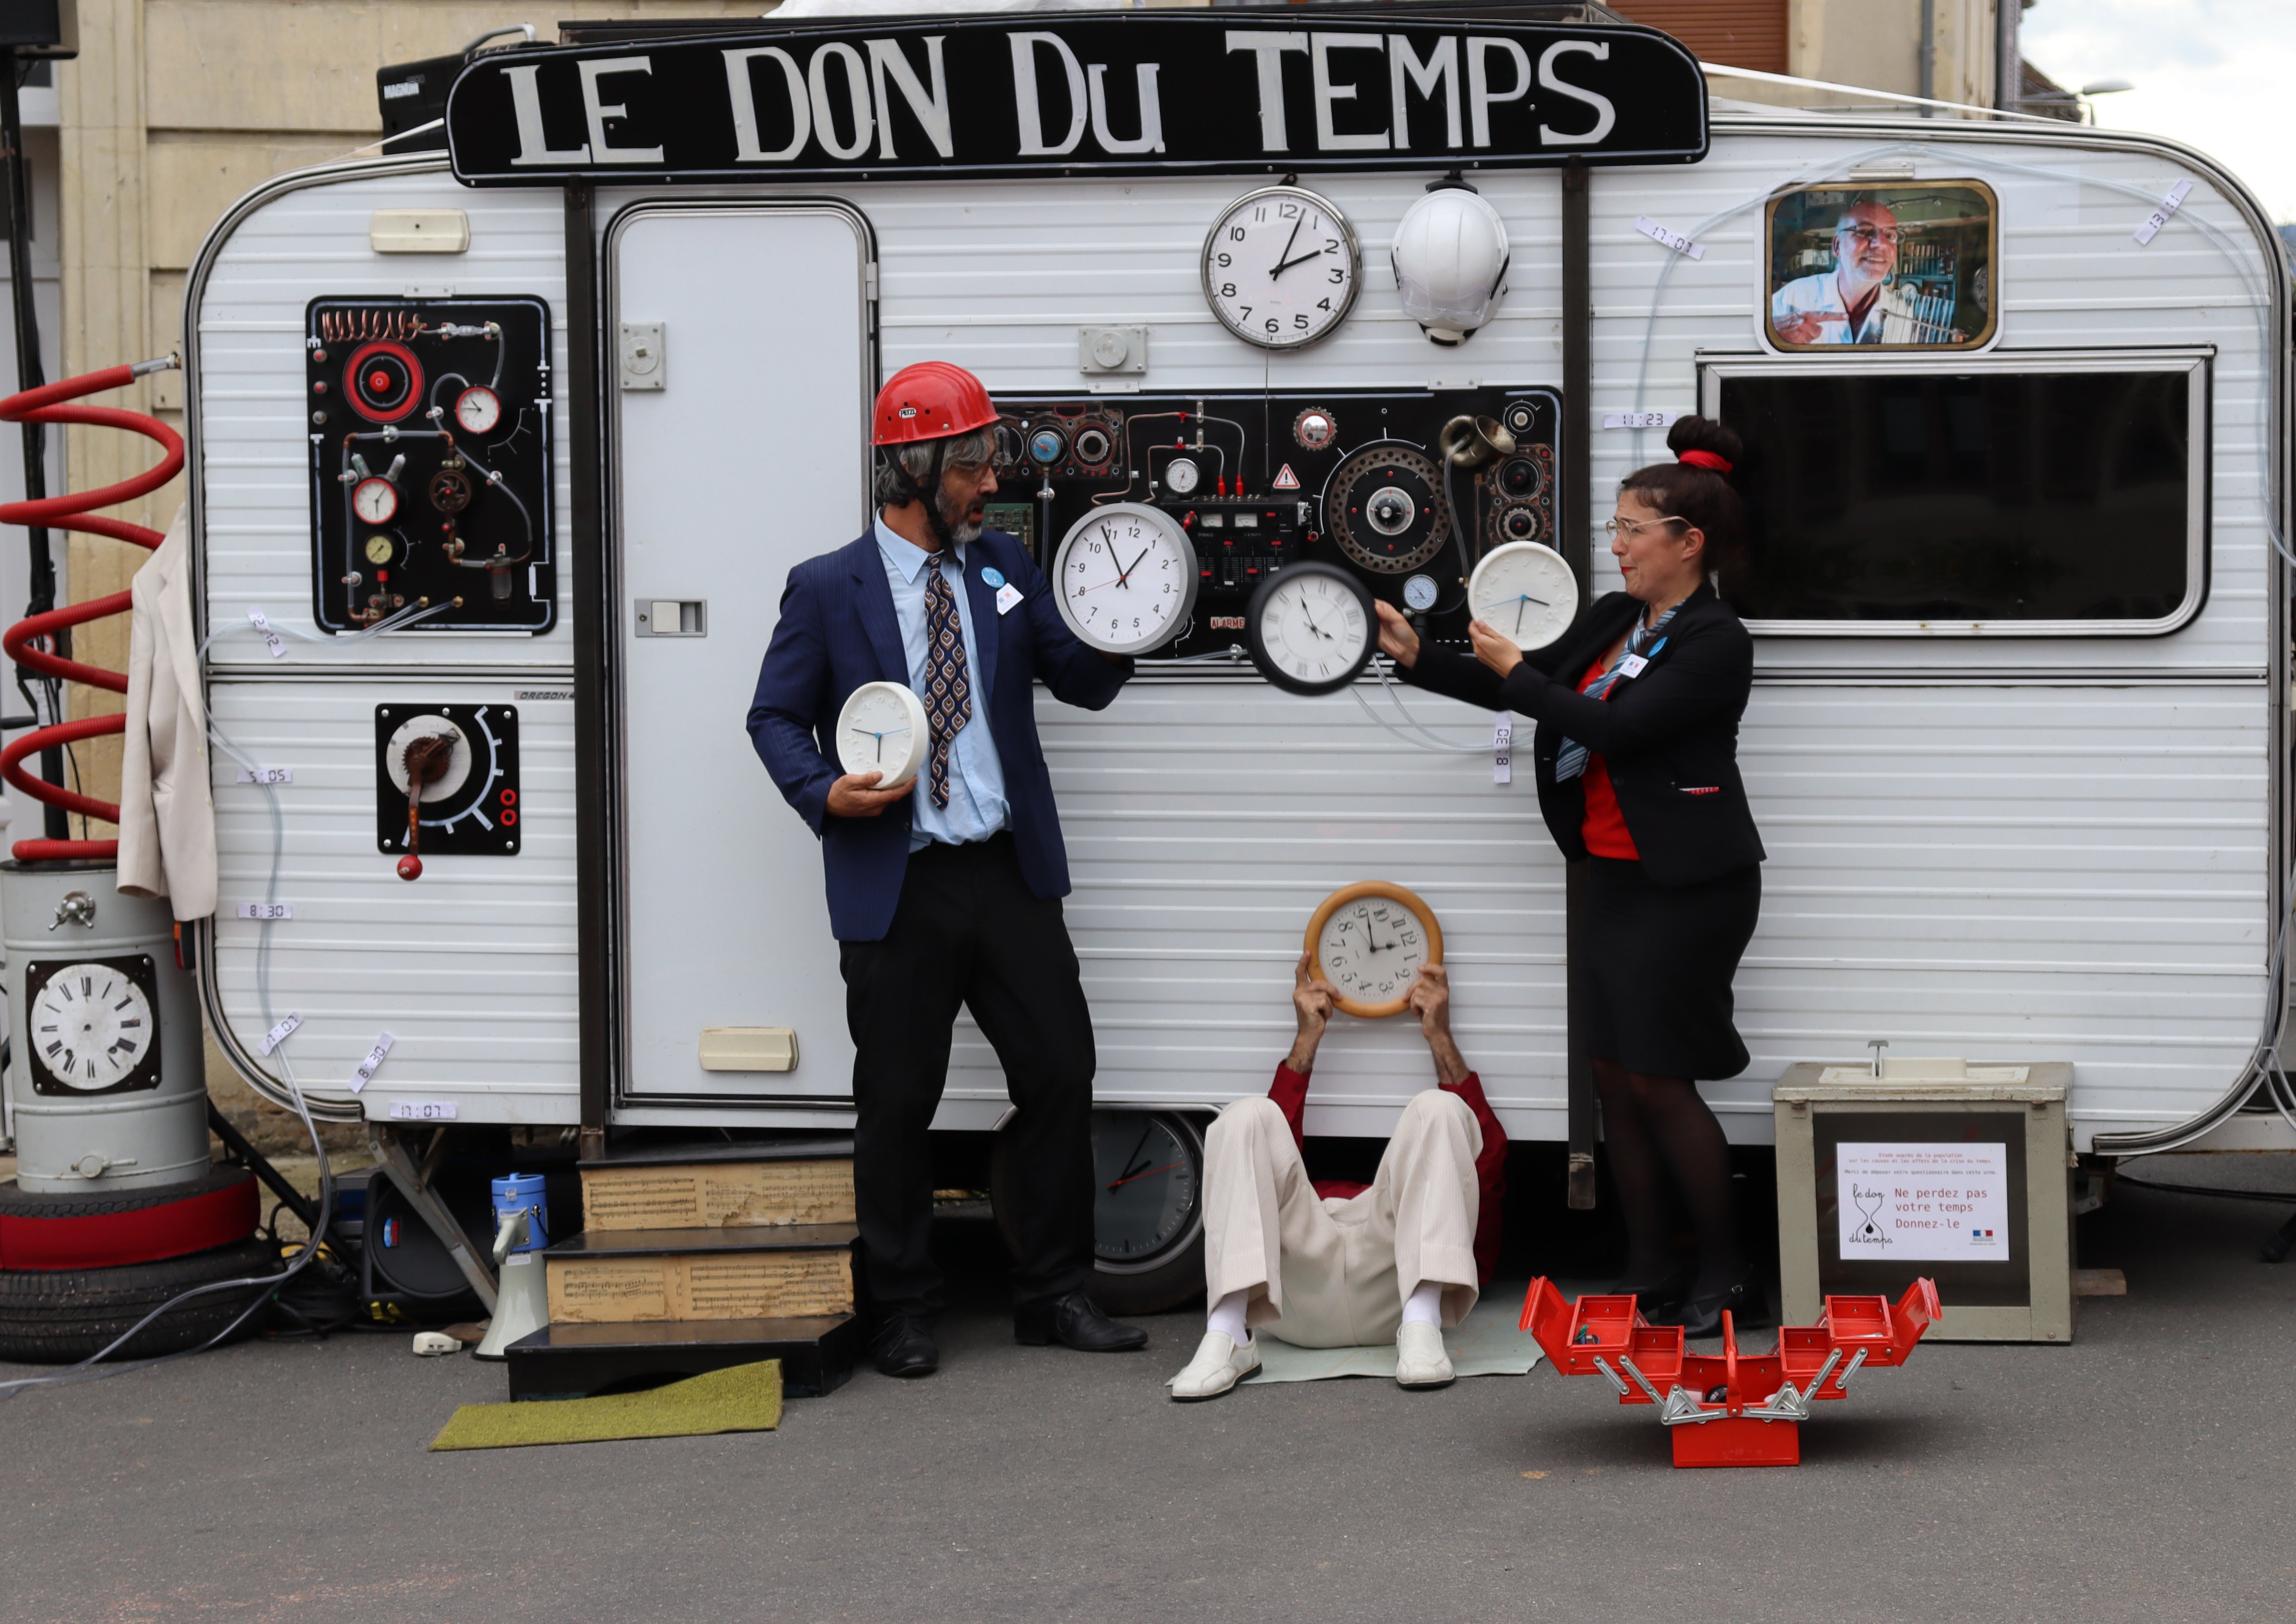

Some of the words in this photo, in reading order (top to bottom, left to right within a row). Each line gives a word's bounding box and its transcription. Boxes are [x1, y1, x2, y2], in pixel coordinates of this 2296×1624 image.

[499, 55, 665, 166] LE
[720, 35, 954, 162] DON
[1225, 30, 1616, 152] TEMPS
[1255, 206, 1266, 222] 11
[1279, 203, 1298, 219] 12
[1314, 215, 1318, 230] 1
[1230, 226, 1245, 241] 10
[1653, 226, 1692, 253] 17:07
[1324, 239, 1339, 254] 2
[1218, 253, 1232, 267] 9
[1328, 268, 1344, 283] 3
[1221, 283, 1237, 297] 8
[1317, 297, 1331, 312] 4
[1240, 306, 1252, 321] 7
[1265, 318, 1279, 332] 6
[1294, 314, 1309, 329] 5
[900, 409, 917, 418] PETZL
[1624, 413, 1663, 426] 11:23
[1107, 528, 1117, 540] 11
[1128, 527, 1140, 538] 12
[1089, 542, 1101, 553] 10
[1151, 540, 1156, 549] 1
[1079, 563, 1085, 573] 9
[1162, 560, 1169, 570] 2
[1079, 586, 1085, 596] 8
[1164, 584, 1170, 593] 3
[1091, 606, 1098, 616] 7
[1153, 604, 1159, 613] 4
[1112, 619, 1118, 629] 6
[1133, 618, 1140, 627] 5
[1496, 729, 1509, 765] 8:30
[250, 905, 283, 917] 8:30
[1354, 907, 1369, 918] 9
[1373, 907, 1389, 922] 10
[1338, 921, 1353, 932] 8
[1331, 938, 1346, 947] 7
[1400, 931, 1417, 947] 12
[1332, 956, 1347, 967] 6
[1342, 972, 1357, 983] 5
[1395, 968, 1411, 980] 2
[1358, 981, 1372, 991] 4
[1379, 981, 1394, 992] 3
[358, 1046, 385, 1079] 8:30
[402, 1106, 440, 1117] 17:07
[1853, 1183, 1863, 1198] le
[1865, 1188, 1885, 1198] don
[1895, 1188, 1909, 1198] Ne
[1917, 1188, 1959, 1199] perdez
[1967, 1190, 1987, 1199] pas
[1896, 1203, 1930, 1212] votre
[1939, 1203, 1973, 1213] temps
[1896, 1218, 1960, 1229] Donnez-le
[1849, 1232, 1861, 1243] du
[1863, 1233, 1893, 1249] temps
